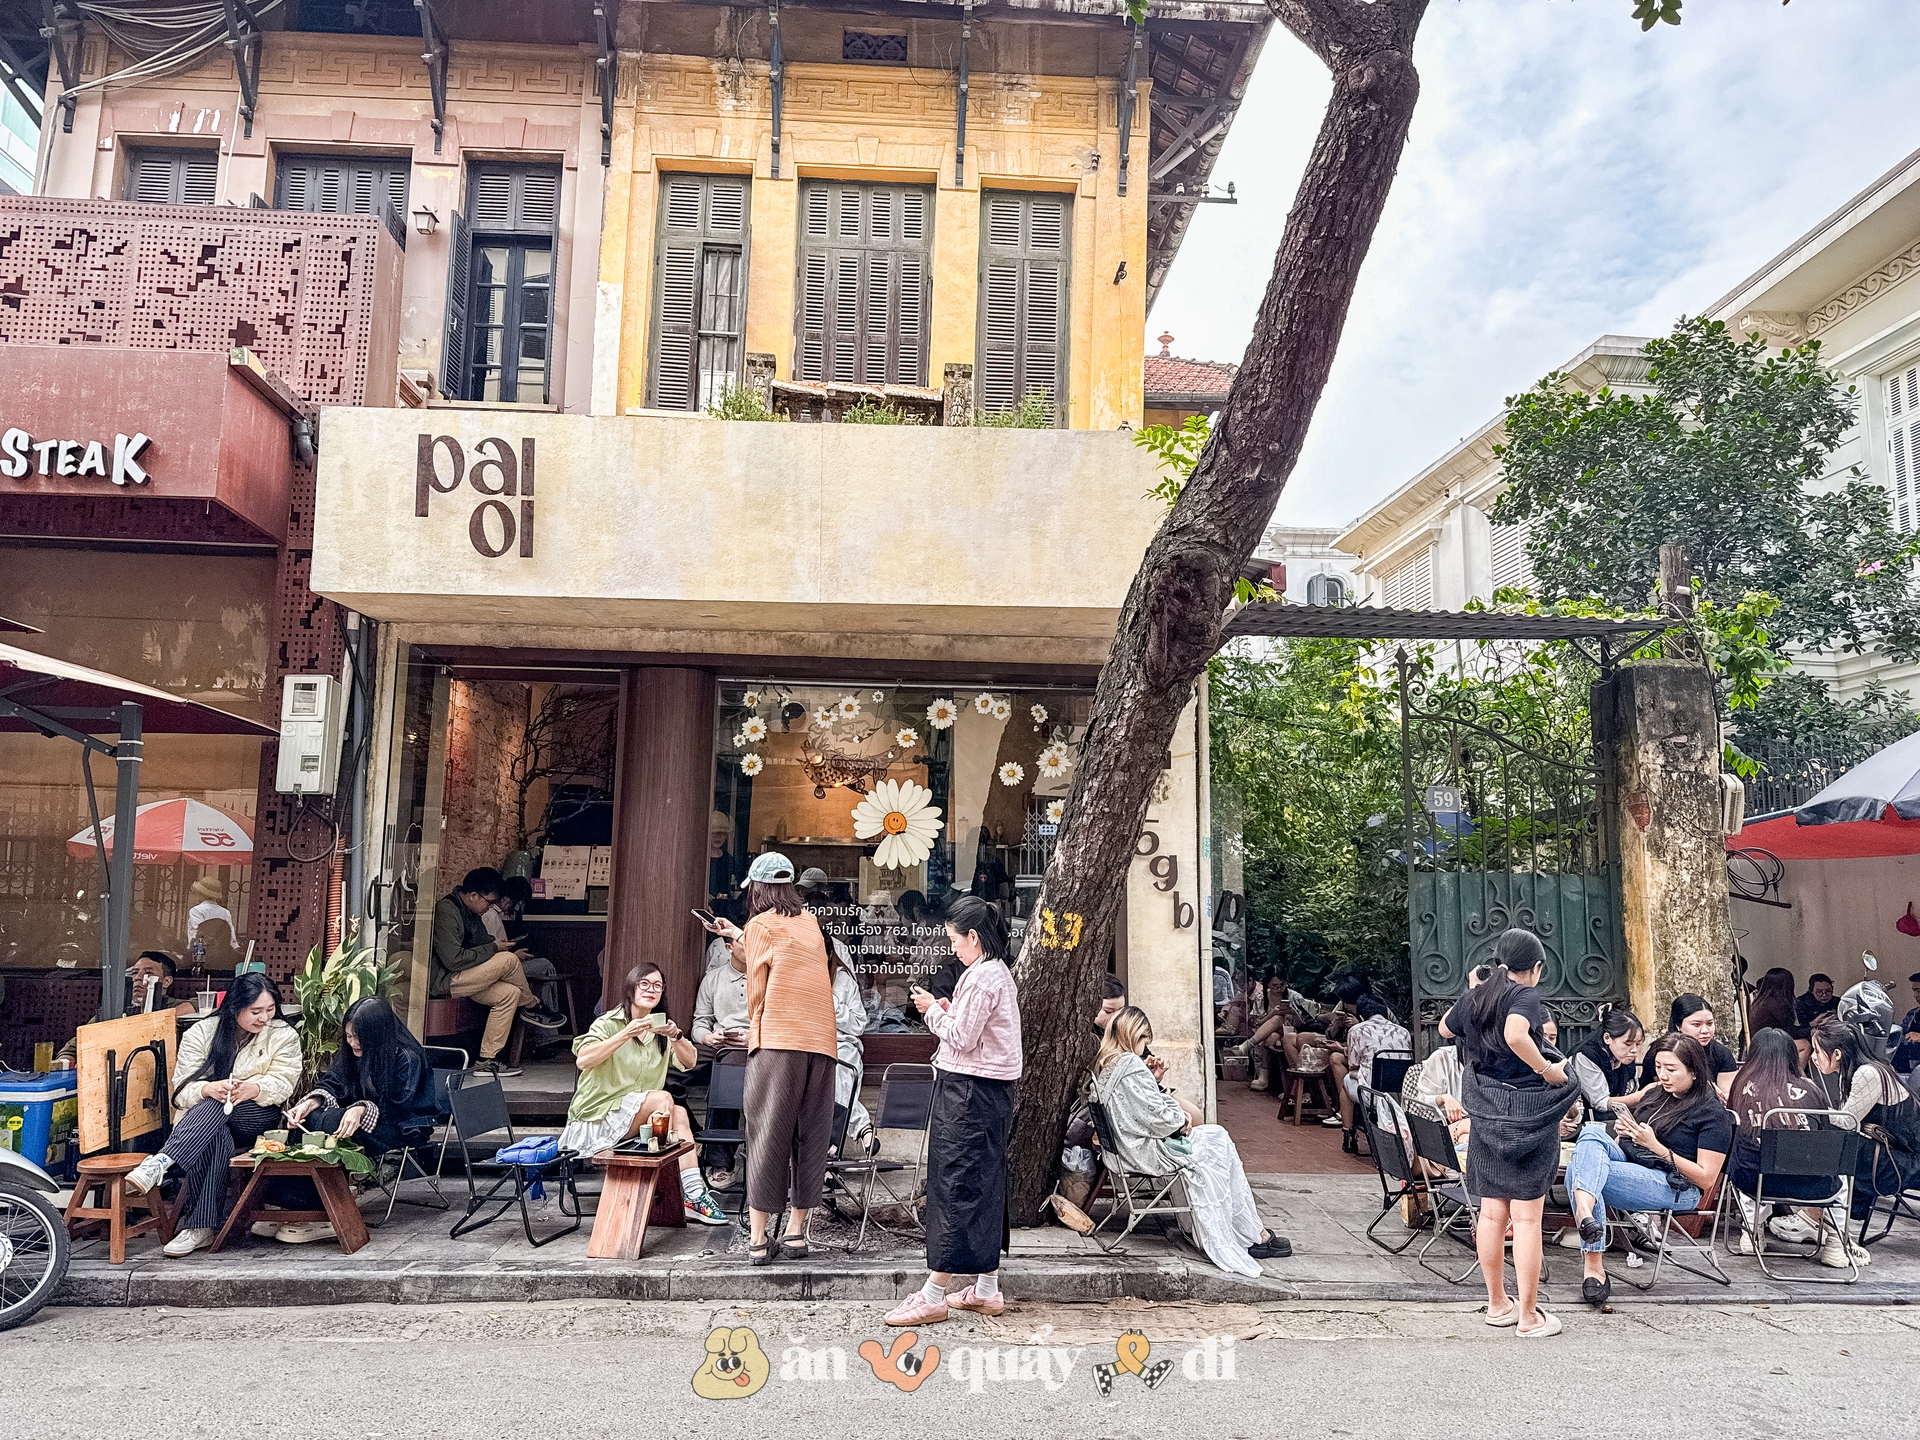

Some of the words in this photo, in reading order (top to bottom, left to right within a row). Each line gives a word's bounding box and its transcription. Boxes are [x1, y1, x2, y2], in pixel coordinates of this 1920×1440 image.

[0, 427, 152, 485] STEAK
[1433, 790, 1454, 808] 59
[885, 926, 908, 937] 762
